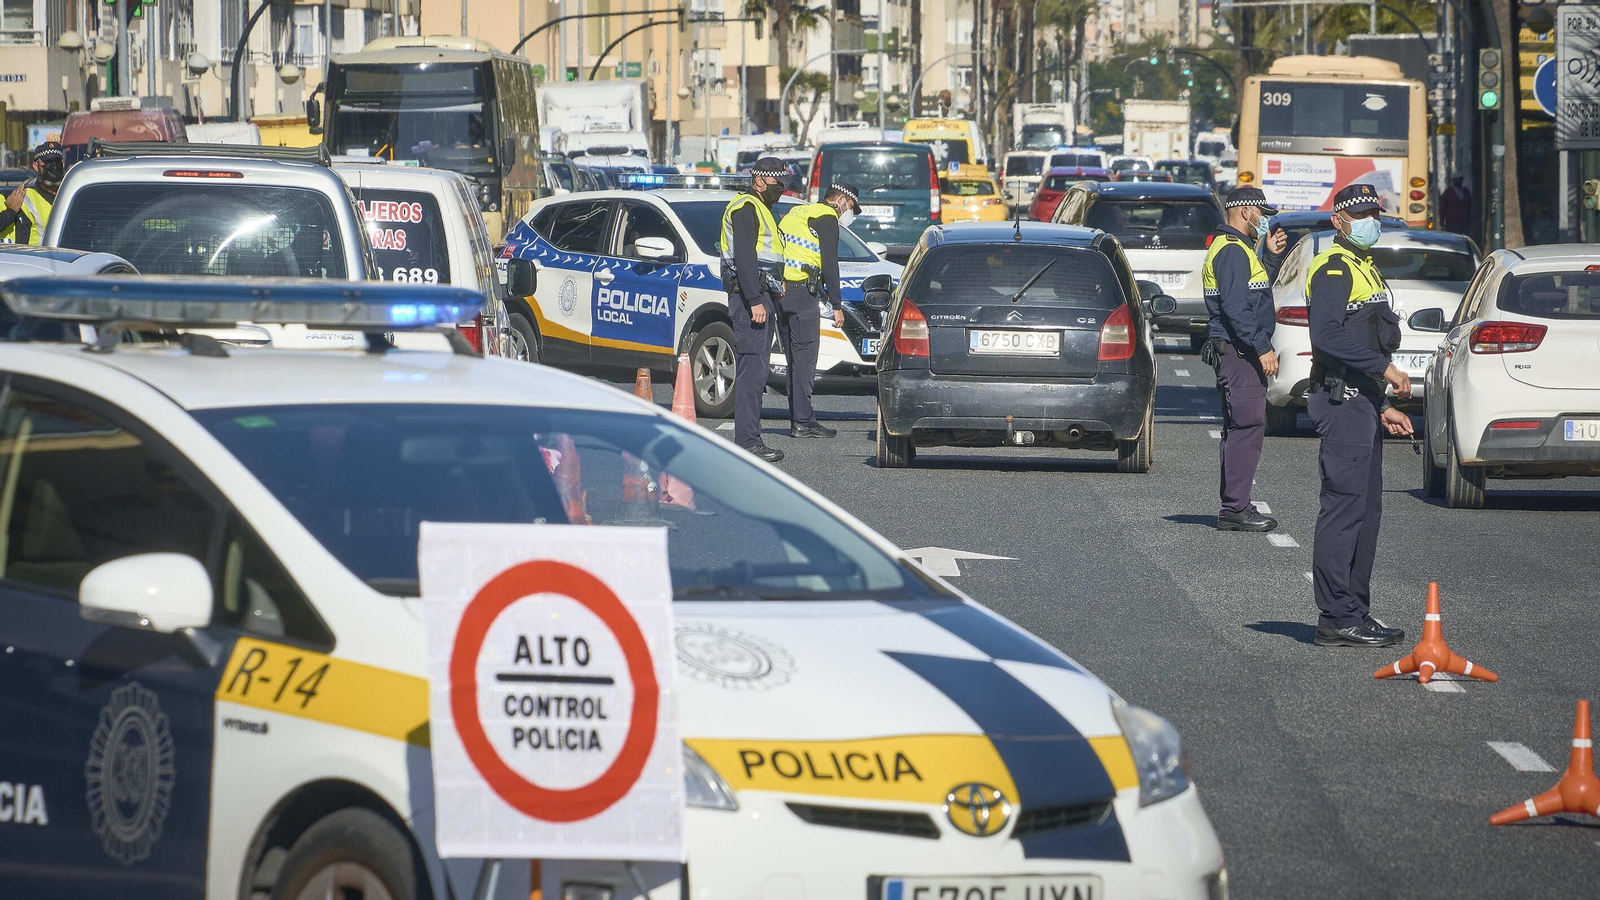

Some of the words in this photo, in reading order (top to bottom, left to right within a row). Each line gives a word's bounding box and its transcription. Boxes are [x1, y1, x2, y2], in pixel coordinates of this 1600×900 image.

[1567, 17, 1582, 30] POR
[1262, 92, 1292, 106] 309
[393, 267, 439, 286] 689
[597, 287, 671, 317] POLICIA
[597, 308, 633, 325] LOCAL
[305, 333, 355, 341] PARTNER
[981, 333, 1020, 347] 6750
[1025, 334, 1055, 349] CXB
[514, 635, 590, 667] ALTO
[226, 647, 331, 709] R-14
[504, 694, 607, 720] CONTROL
[513, 726, 603, 751] POLICIA
[738, 750, 924, 782] POLICIA
[0, 781, 49, 826] CIA
